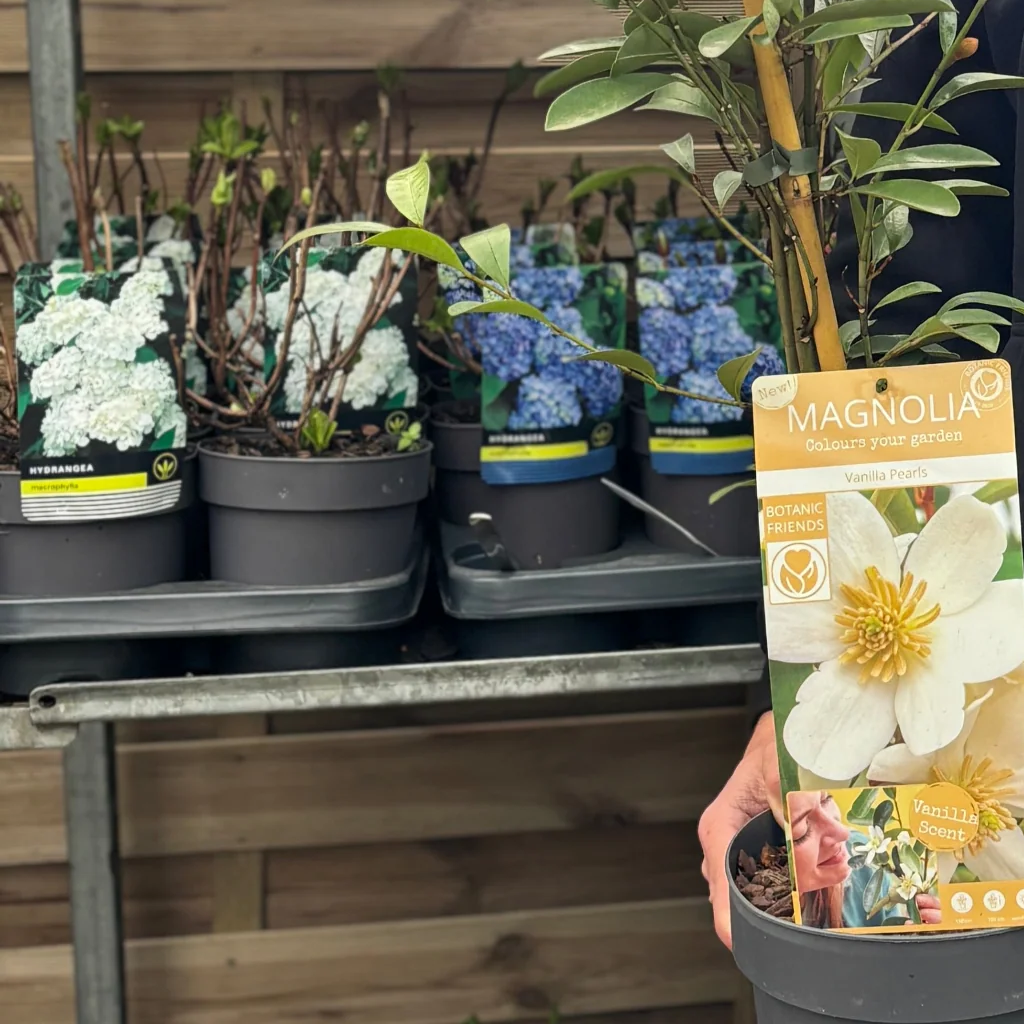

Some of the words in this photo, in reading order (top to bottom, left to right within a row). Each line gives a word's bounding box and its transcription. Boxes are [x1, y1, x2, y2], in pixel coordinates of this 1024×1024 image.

[757, 379, 793, 401] New!
[787, 390, 981, 433] MAGNOLIA
[805, 438, 867, 452] Colours
[870, 435, 907, 451] your
[910, 429, 963, 447] garden
[29, 463, 95, 475] HYDRANGEA
[845, 469, 886, 484] Vanilla
[890, 465, 928, 481] Pearls
[766, 502, 824, 518] BOTANIC
[767, 518, 825, 535] FRIENDS
[913, 798, 979, 826] Vanilla
[918, 820, 967, 843] Scent
